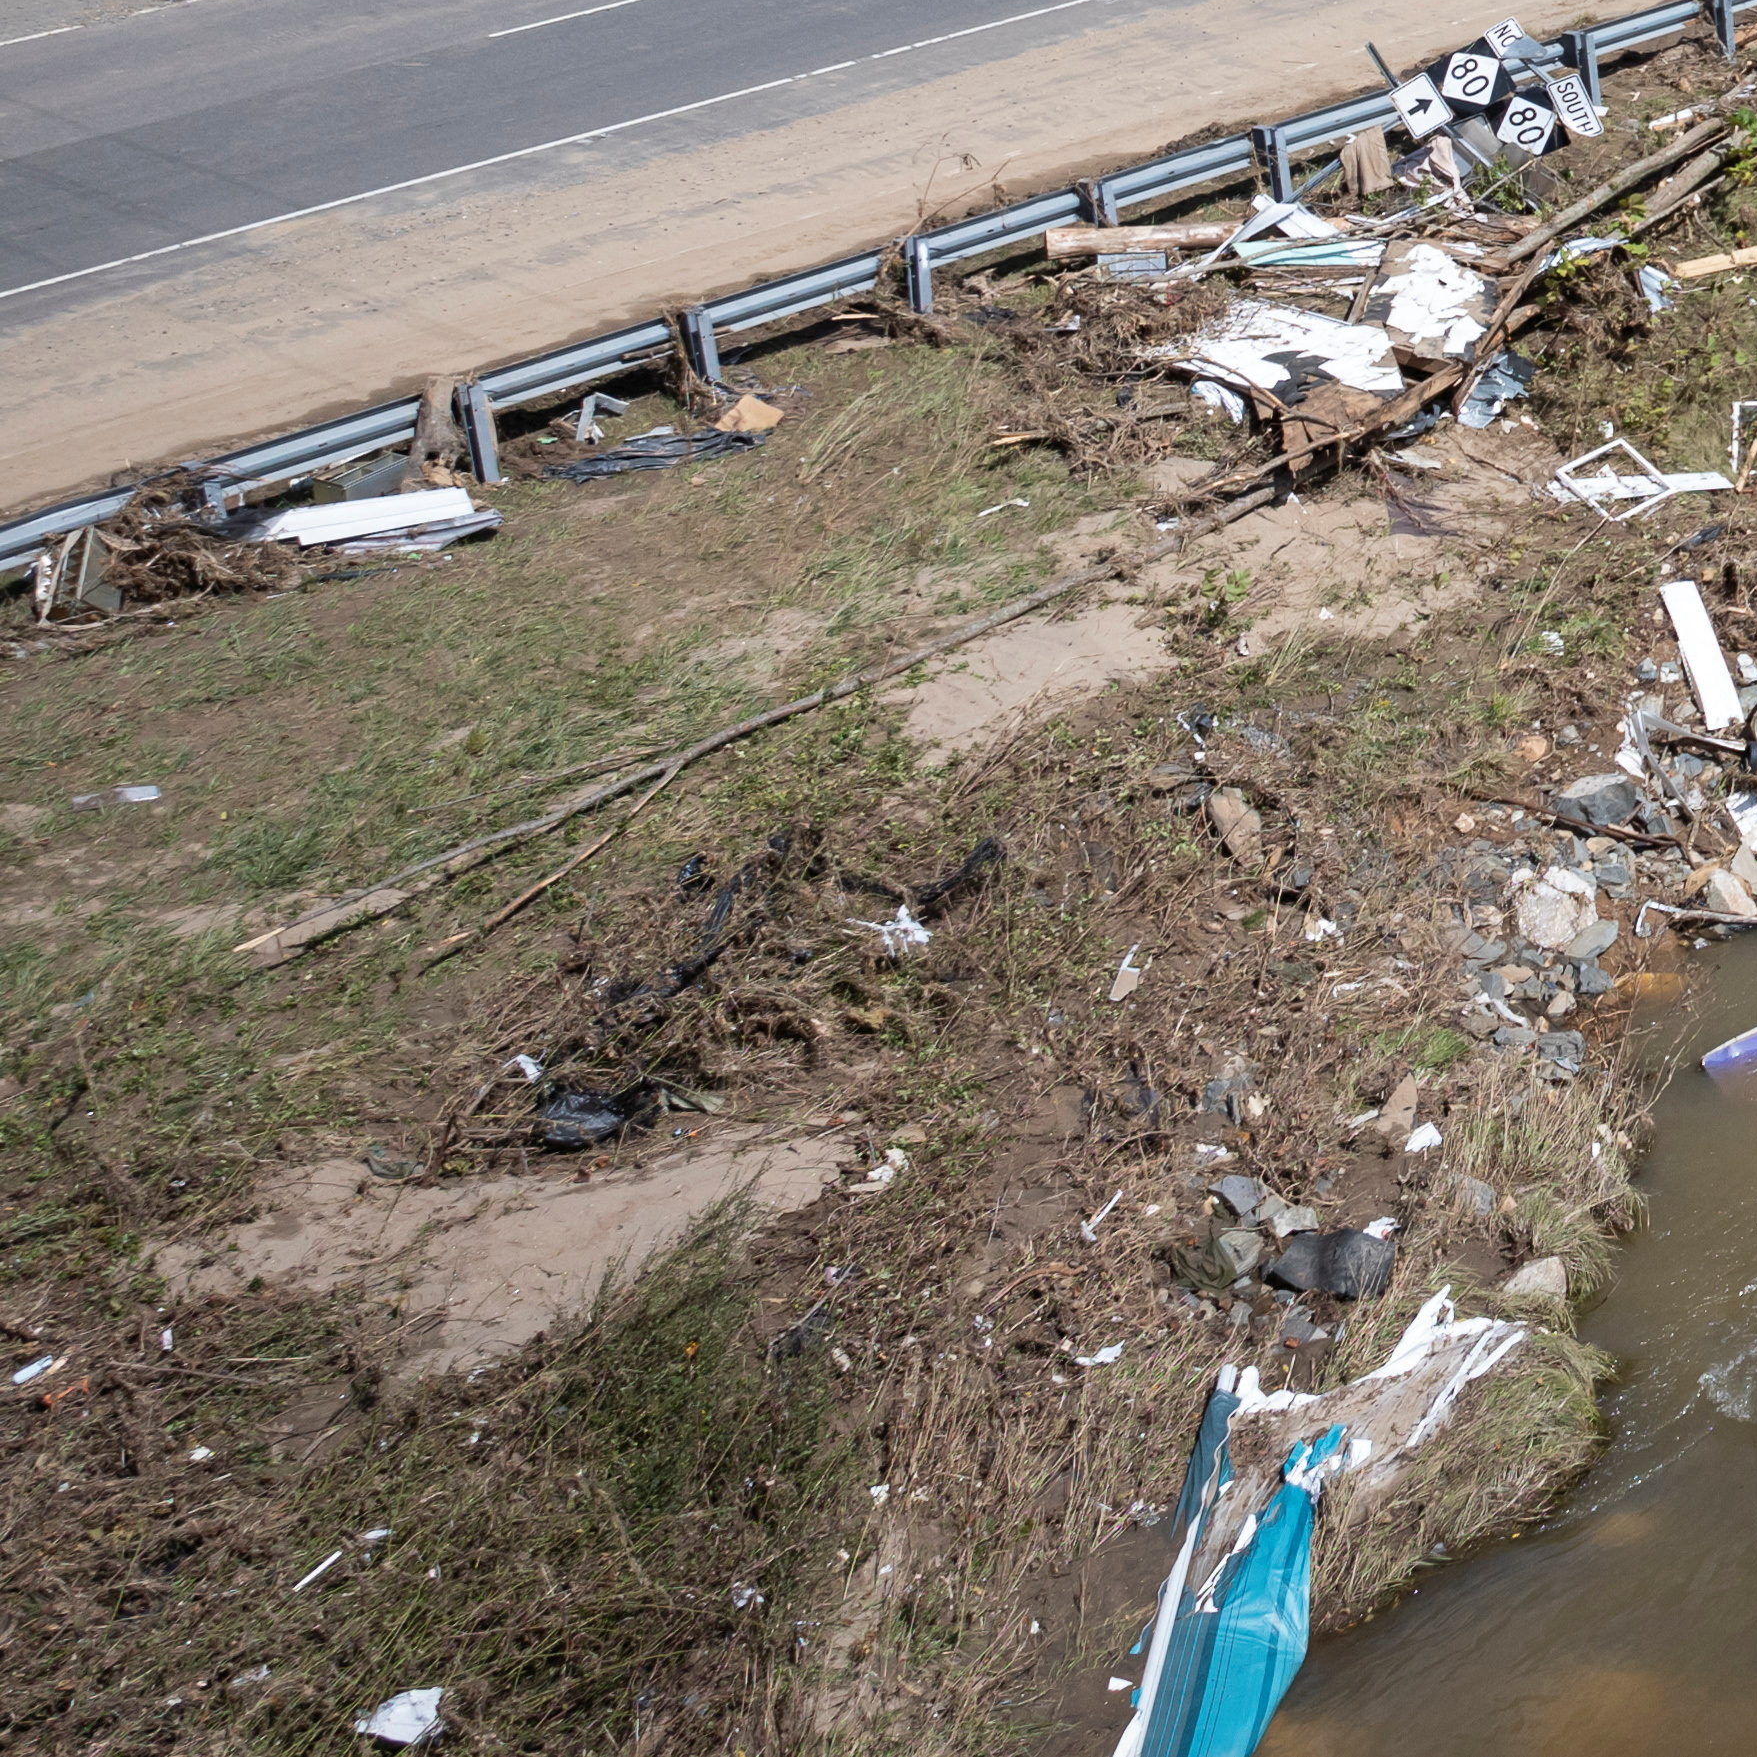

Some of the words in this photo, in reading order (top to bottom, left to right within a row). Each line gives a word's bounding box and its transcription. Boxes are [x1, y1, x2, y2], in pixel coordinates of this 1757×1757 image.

[1451, 58, 1489, 96] 80
[1509, 107, 1545, 145] 80
[1556, 82, 1594, 133] SOUTH
